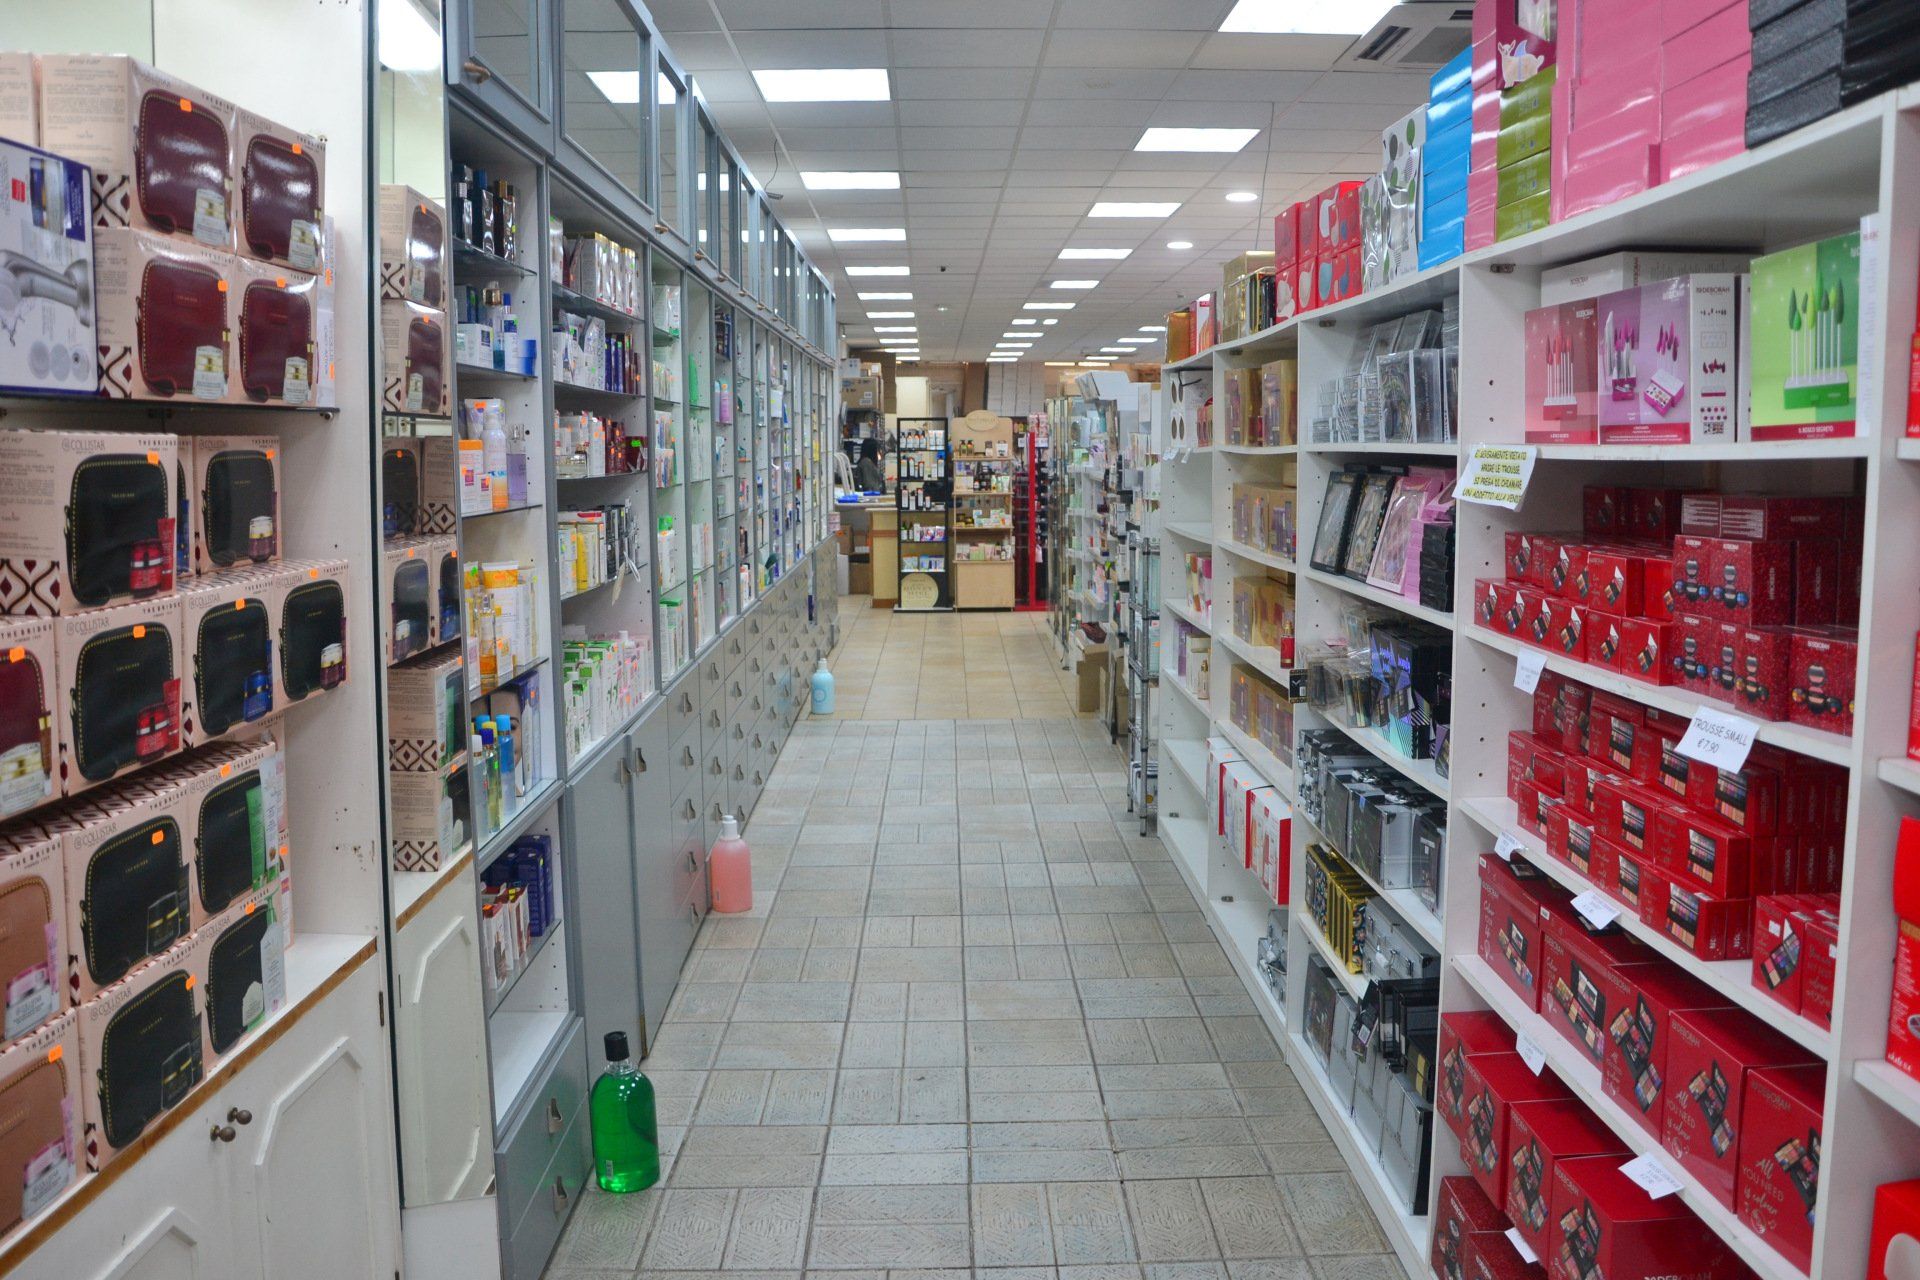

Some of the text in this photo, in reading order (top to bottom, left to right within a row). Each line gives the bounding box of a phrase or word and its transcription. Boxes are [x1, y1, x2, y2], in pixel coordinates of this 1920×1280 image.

[70, 439, 106, 451] COLLISTAR
[20, 624, 52, 637] BRIDGE
[74, 617, 110, 634] COLLISTAR
[1694, 718, 1748, 746] TROUSSE SMALL
[29, 842, 62, 862] BRIDGE
[1676, 1024, 1701, 1048] DEBORAH
[1759, 1086, 1792, 1113] DEBORAH
[1680, 1110, 1696, 1129] NEED
[1756, 1158, 1774, 1180] All
[1760, 1178, 1785, 1202] NEED
